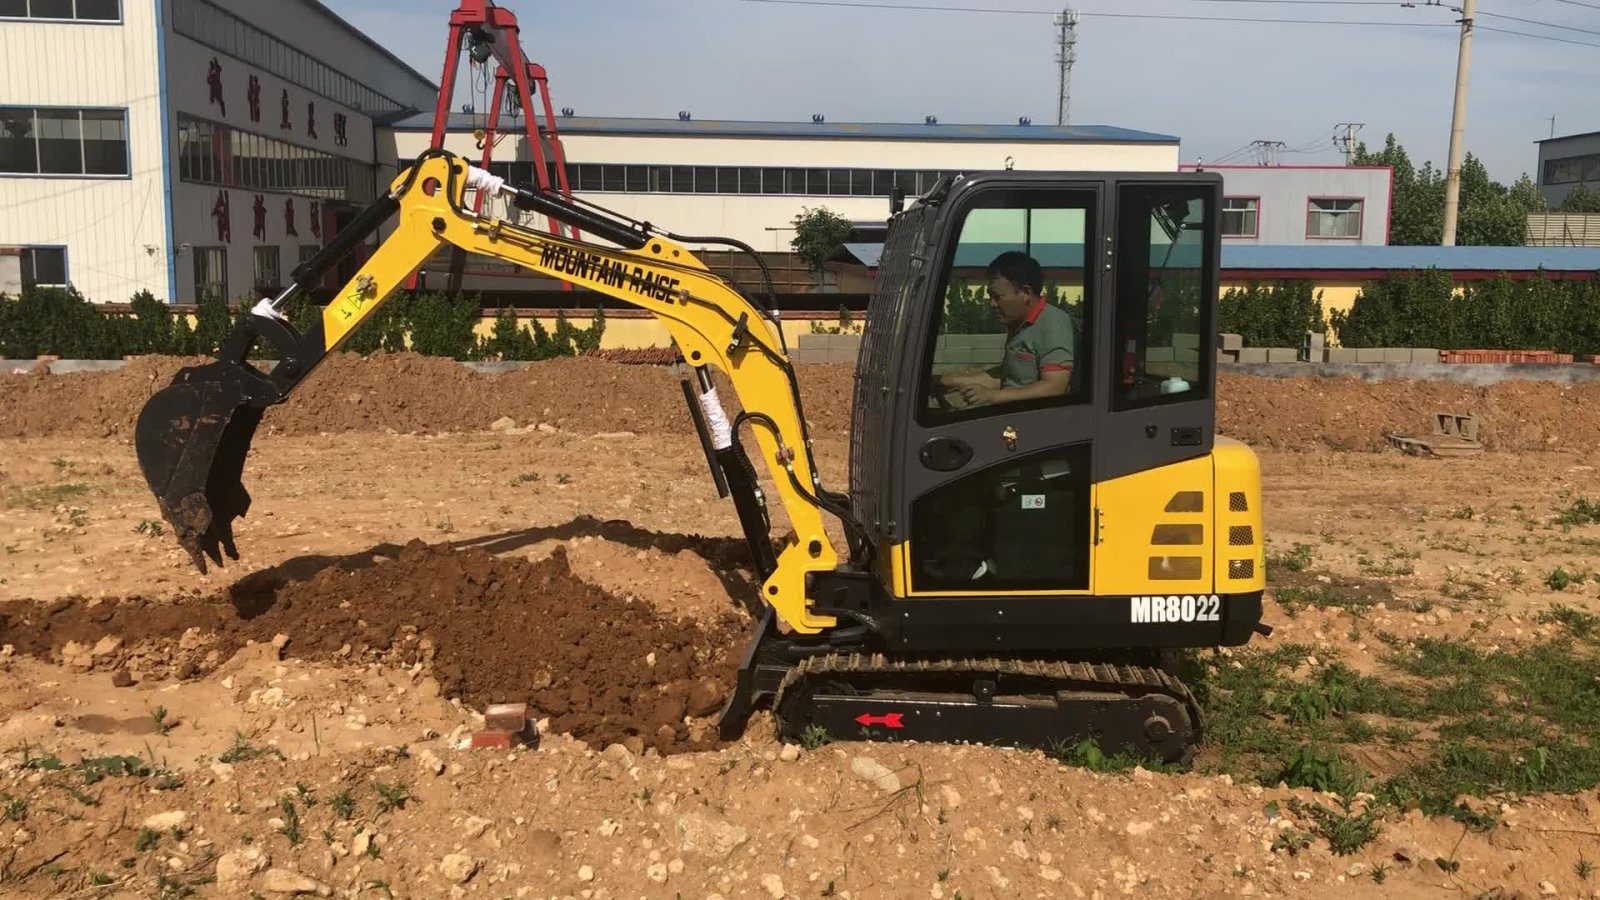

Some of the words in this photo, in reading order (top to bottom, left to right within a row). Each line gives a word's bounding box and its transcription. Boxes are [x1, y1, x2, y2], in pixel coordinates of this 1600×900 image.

[539, 243, 629, 289] MOUNTAIN
[629, 266, 681, 304] RAISE
[1130, 594, 1221, 624] MR8022
